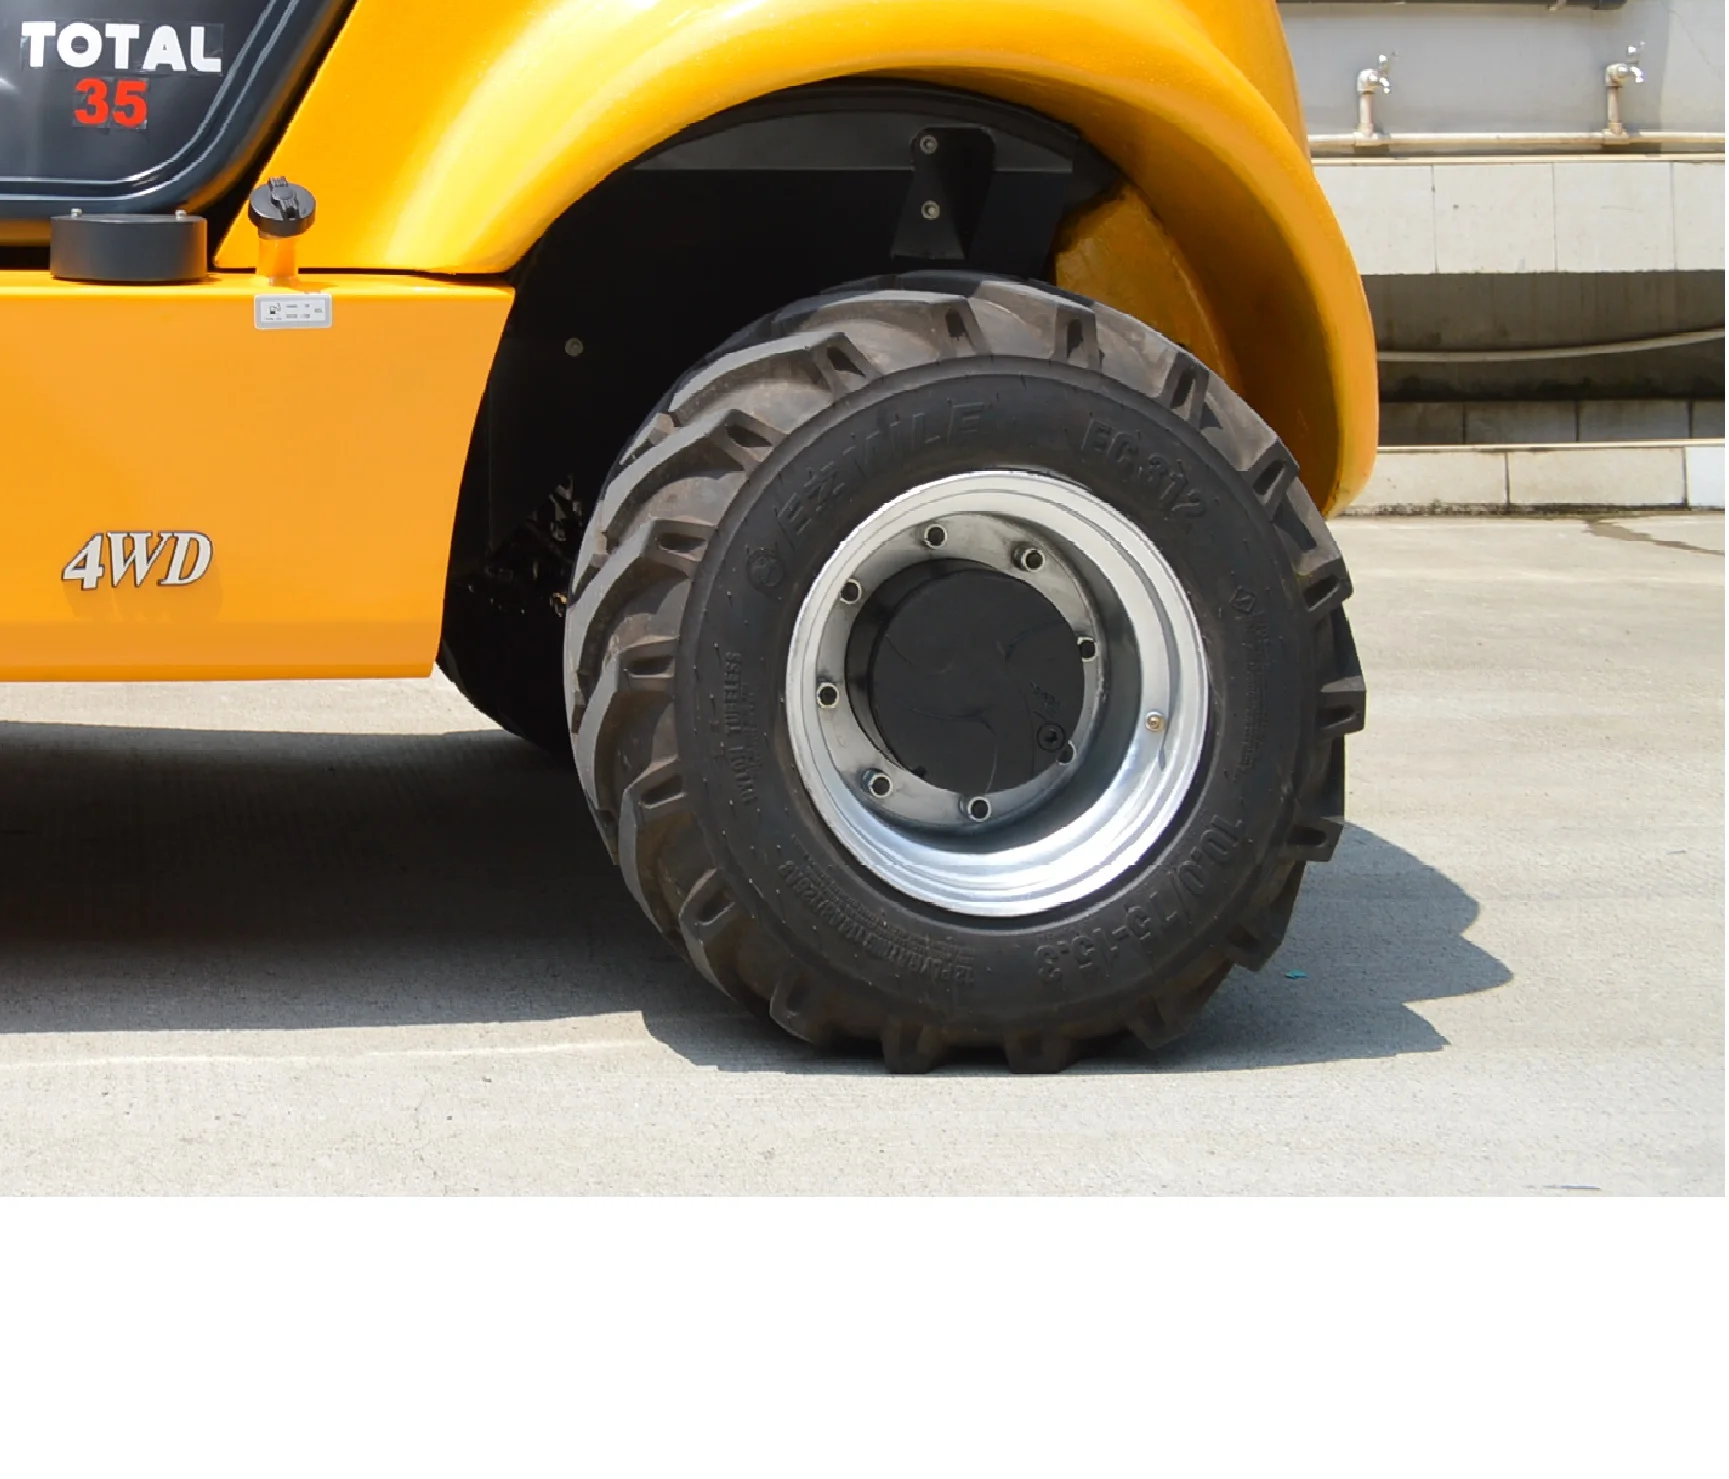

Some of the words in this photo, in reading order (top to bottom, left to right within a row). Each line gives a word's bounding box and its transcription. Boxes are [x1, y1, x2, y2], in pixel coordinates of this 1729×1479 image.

[21, 21, 222, 73] TOTAL
[74, 77, 148, 127] 35
[61, 529, 214, 591] 4WD
